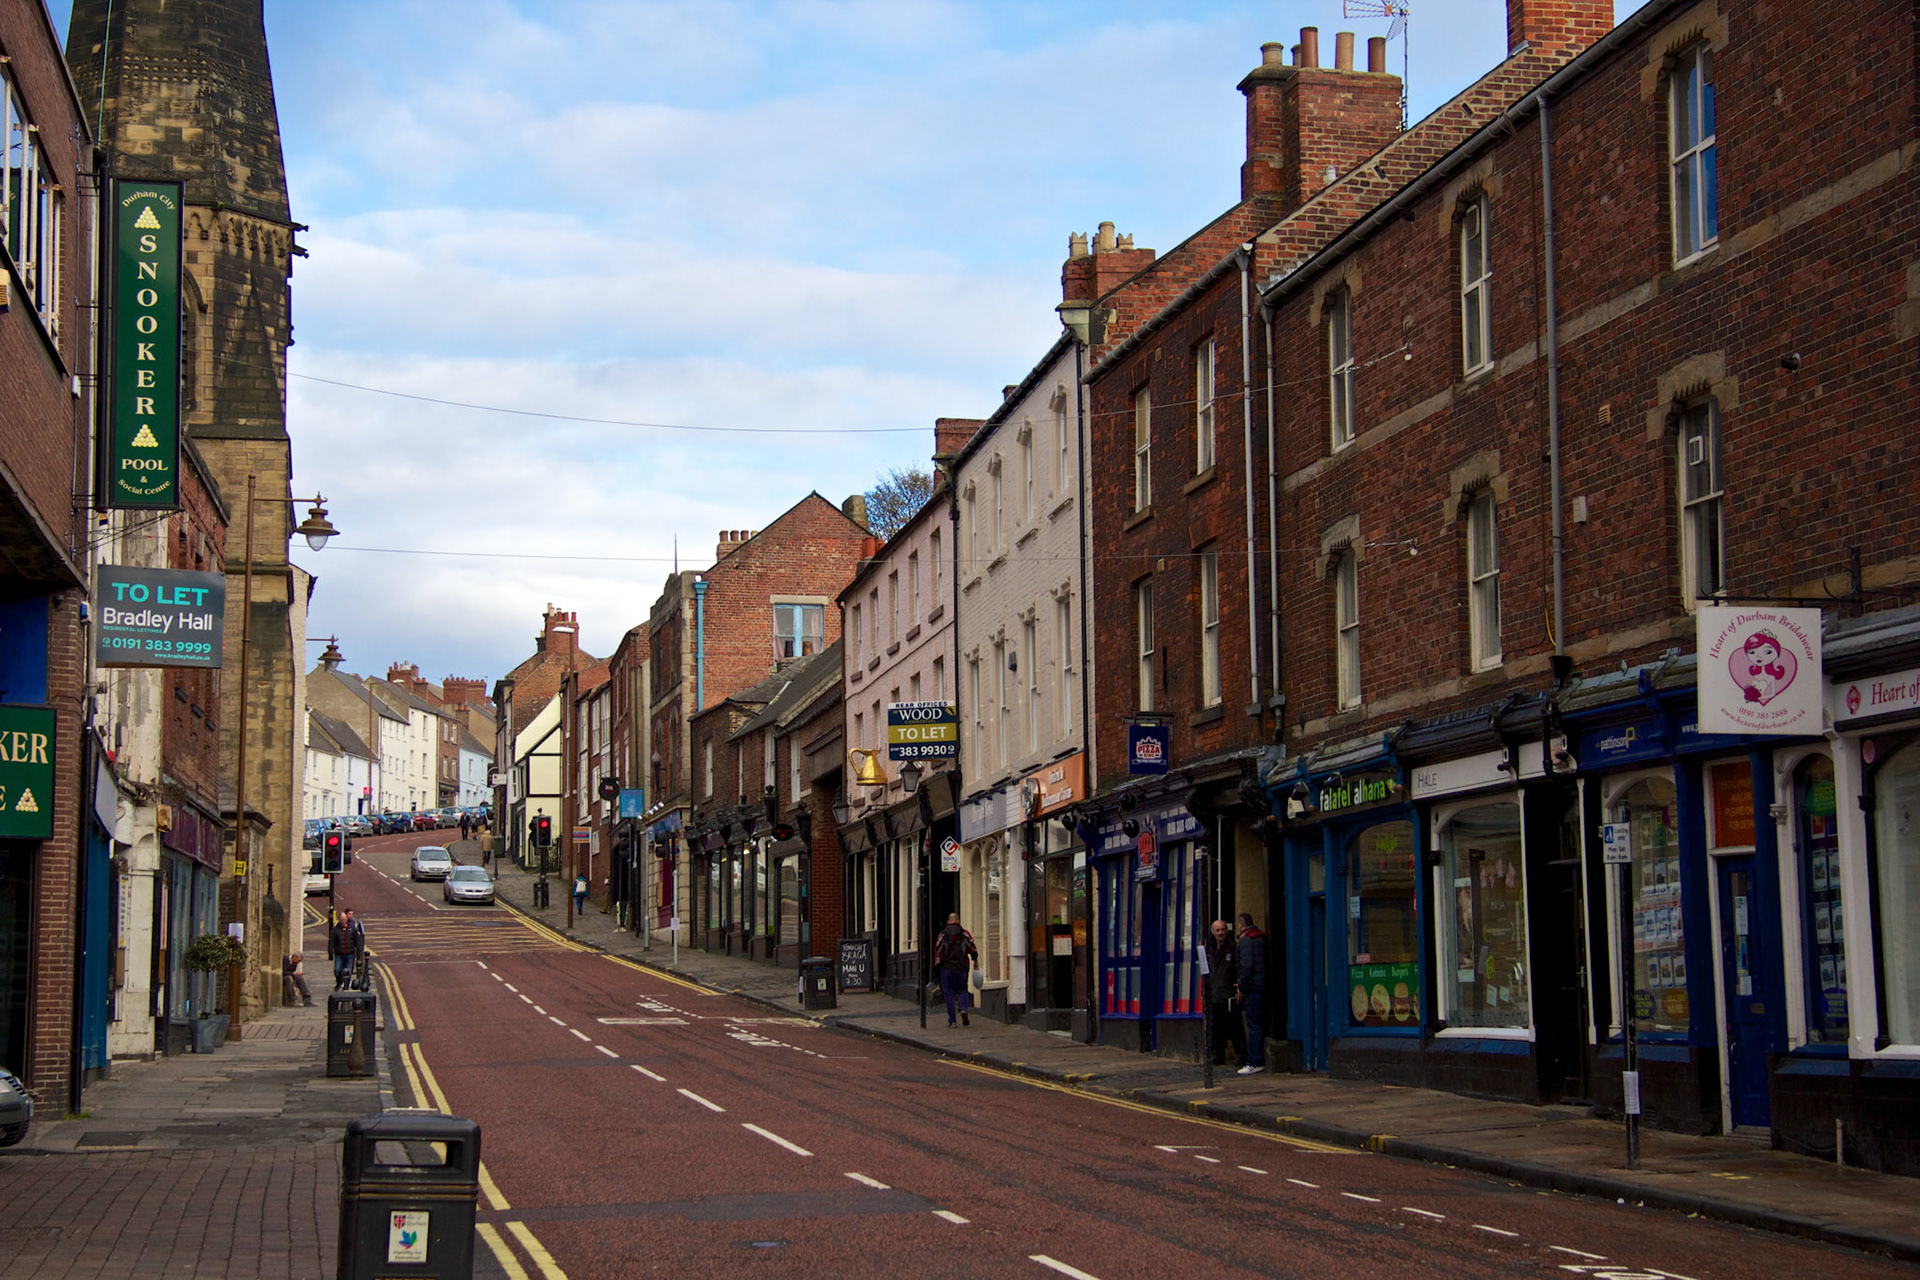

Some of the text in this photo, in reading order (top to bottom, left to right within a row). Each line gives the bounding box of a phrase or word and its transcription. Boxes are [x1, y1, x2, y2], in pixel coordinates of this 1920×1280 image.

[122, 191, 176, 210] Durham City
[135, 234, 159, 415] SNOOKER
[121, 458, 169, 471] POOL
[118, 479, 171, 495] Social Centre
[140, 475, 148, 484] &
[111, 582, 209, 607] TO LET
[103, 607, 213, 634] Bradley Hall
[1709, 611, 1815, 661] Heart of Durham Bridalwear
[112, 637, 212, 654] 0191 383 9999
[154, 652, 211, 661] www.bradleyhall.co.uk
[1871, 682, 1906, 705] Heart
[899, 708, 943, 720] WOOD
[1738, 707, 1754, 719] 0191
[897, 726, 947, 740] TO LET
[899, 746, 919, 757] 383
[920, 744, 947, 756] 9930
[1137, 744, 1160, 754] PIZZA
[1600, 735, 1629, 753] pattinson
[1417, 772, 1438, 788] HALE
[1320, 778, 1386, 812] falafel alhana
[841, 950, 867, 962] BRAGA
[842, 963, 865, 974] MAN U
